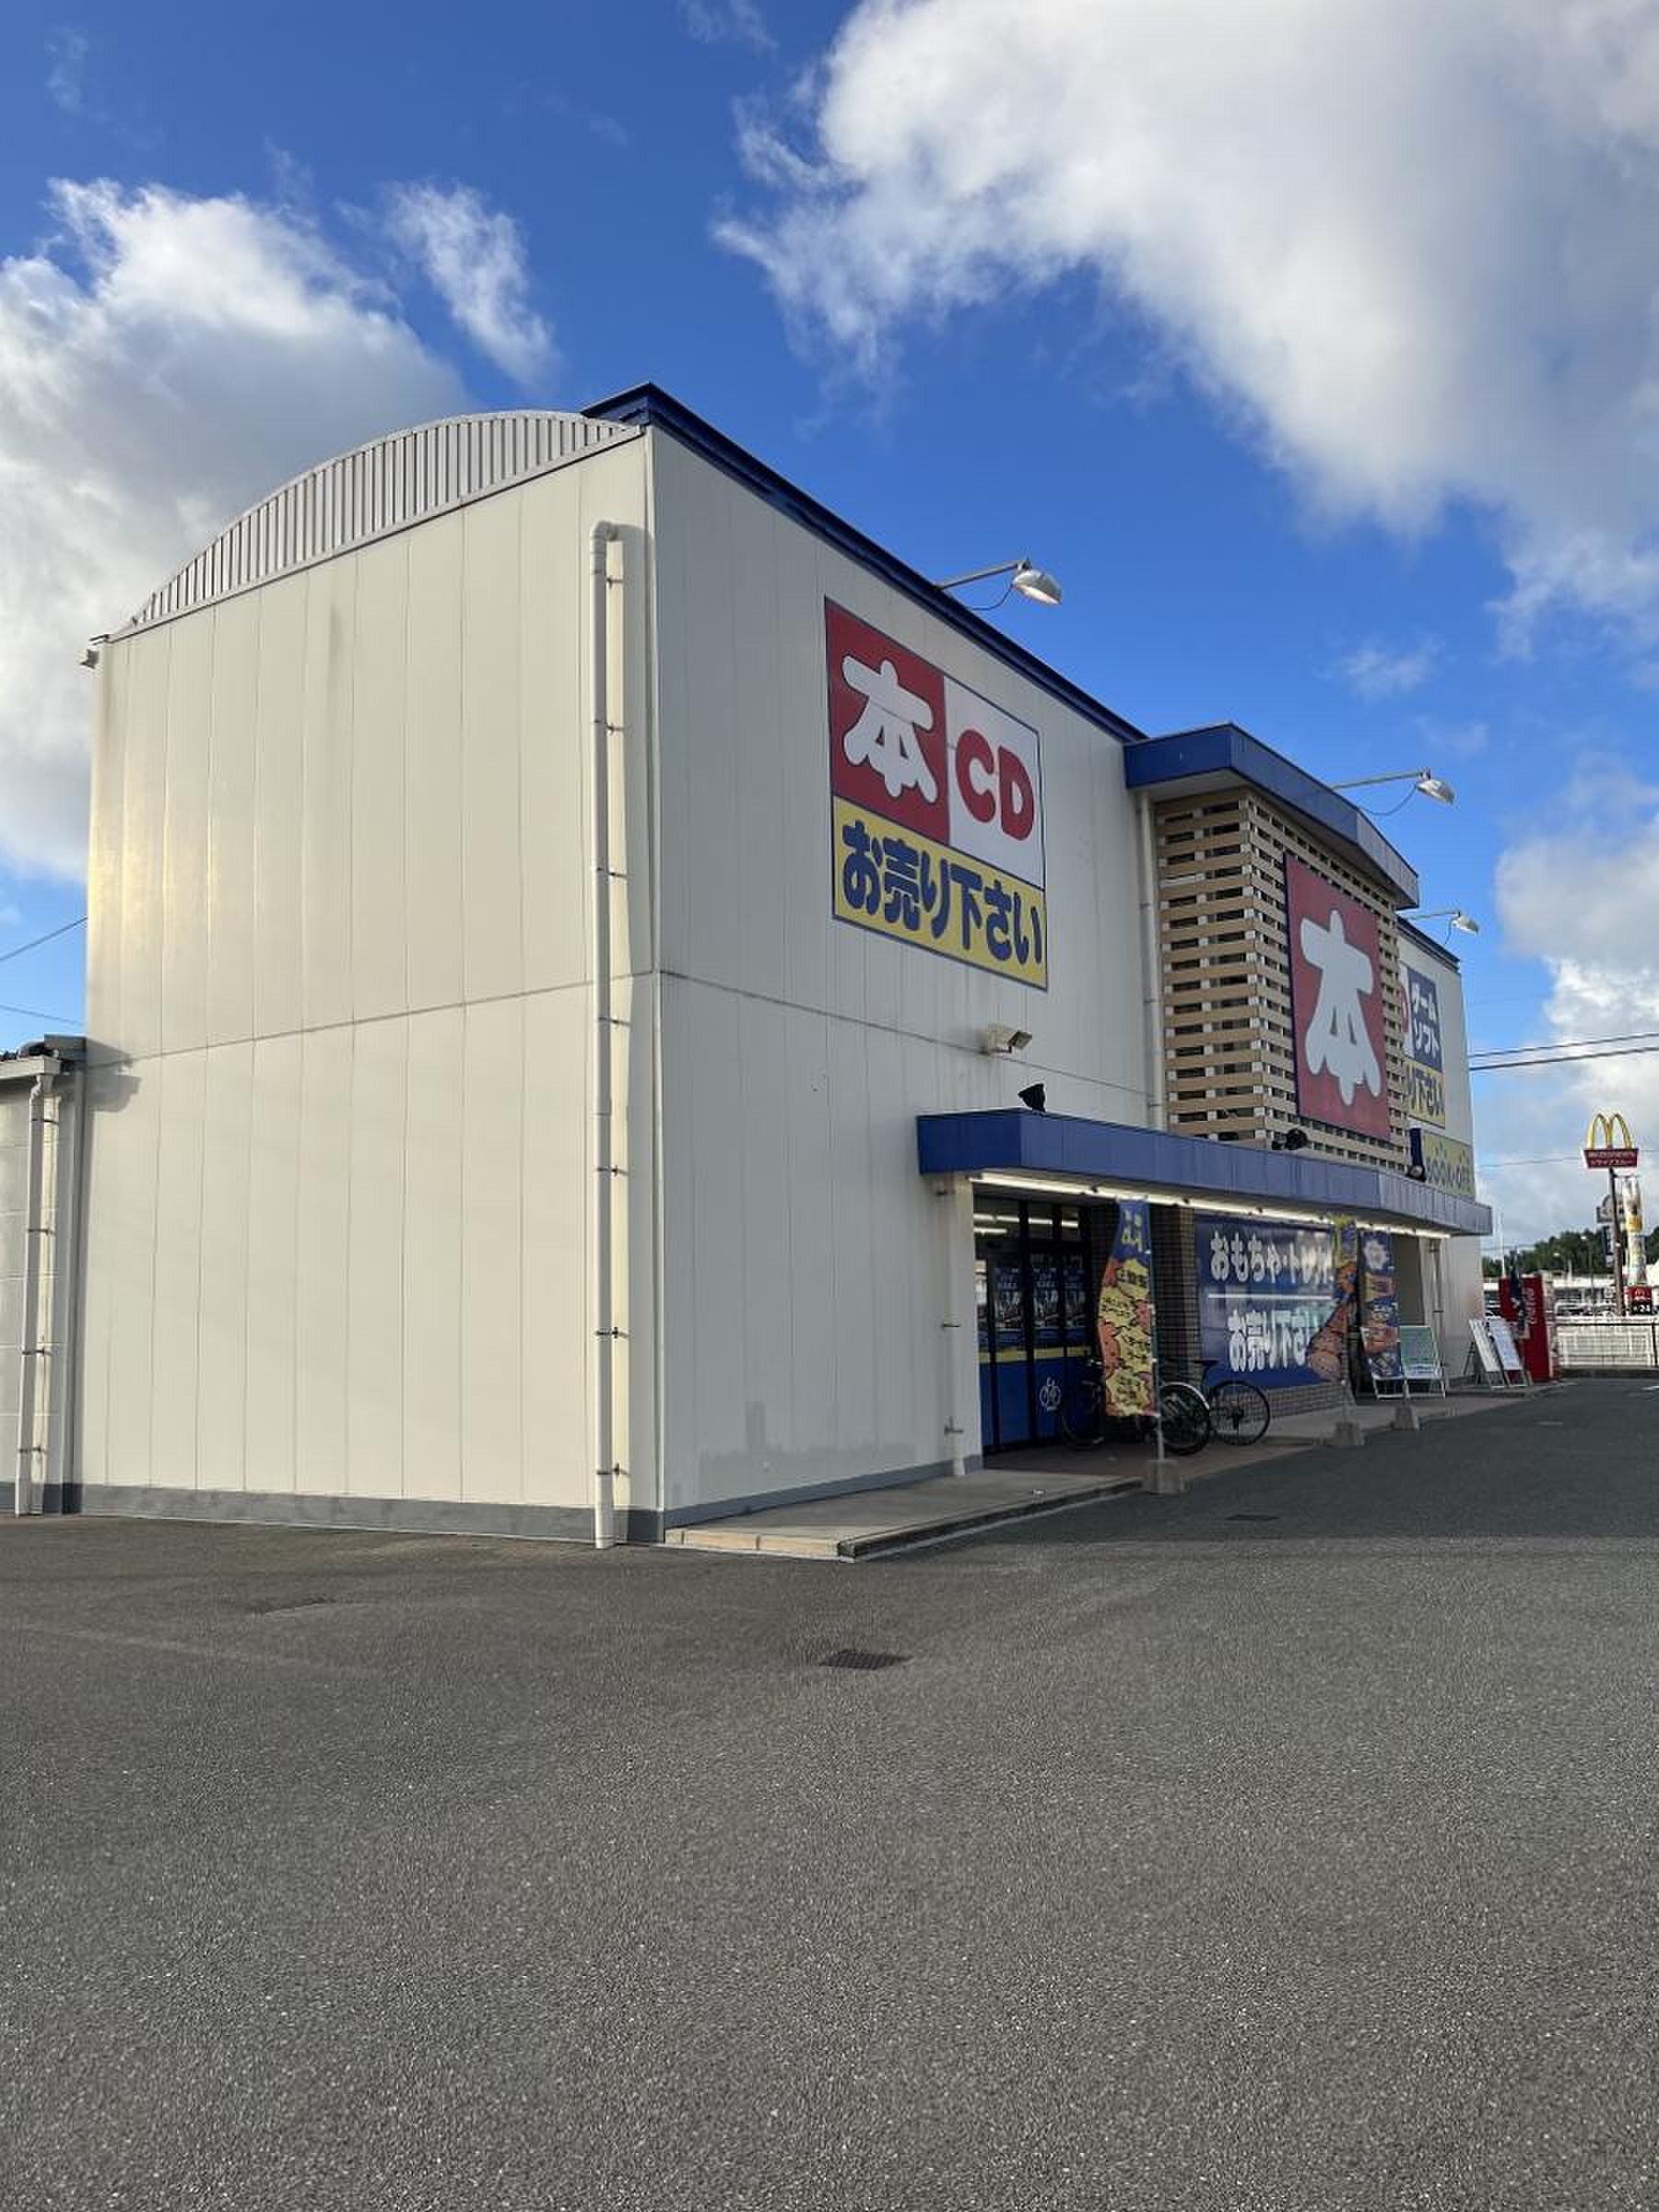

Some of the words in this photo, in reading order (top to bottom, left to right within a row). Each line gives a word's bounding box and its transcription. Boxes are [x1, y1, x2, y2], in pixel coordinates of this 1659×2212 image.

[841, 653, 937, 804] 本
[955, 728, 1035, 841] CD
[842, 819, 1042, 965] お売り下さい
[1300, 909, 1382, 1106] 本
[1414, 1018, 1440, 1059] ソフト
